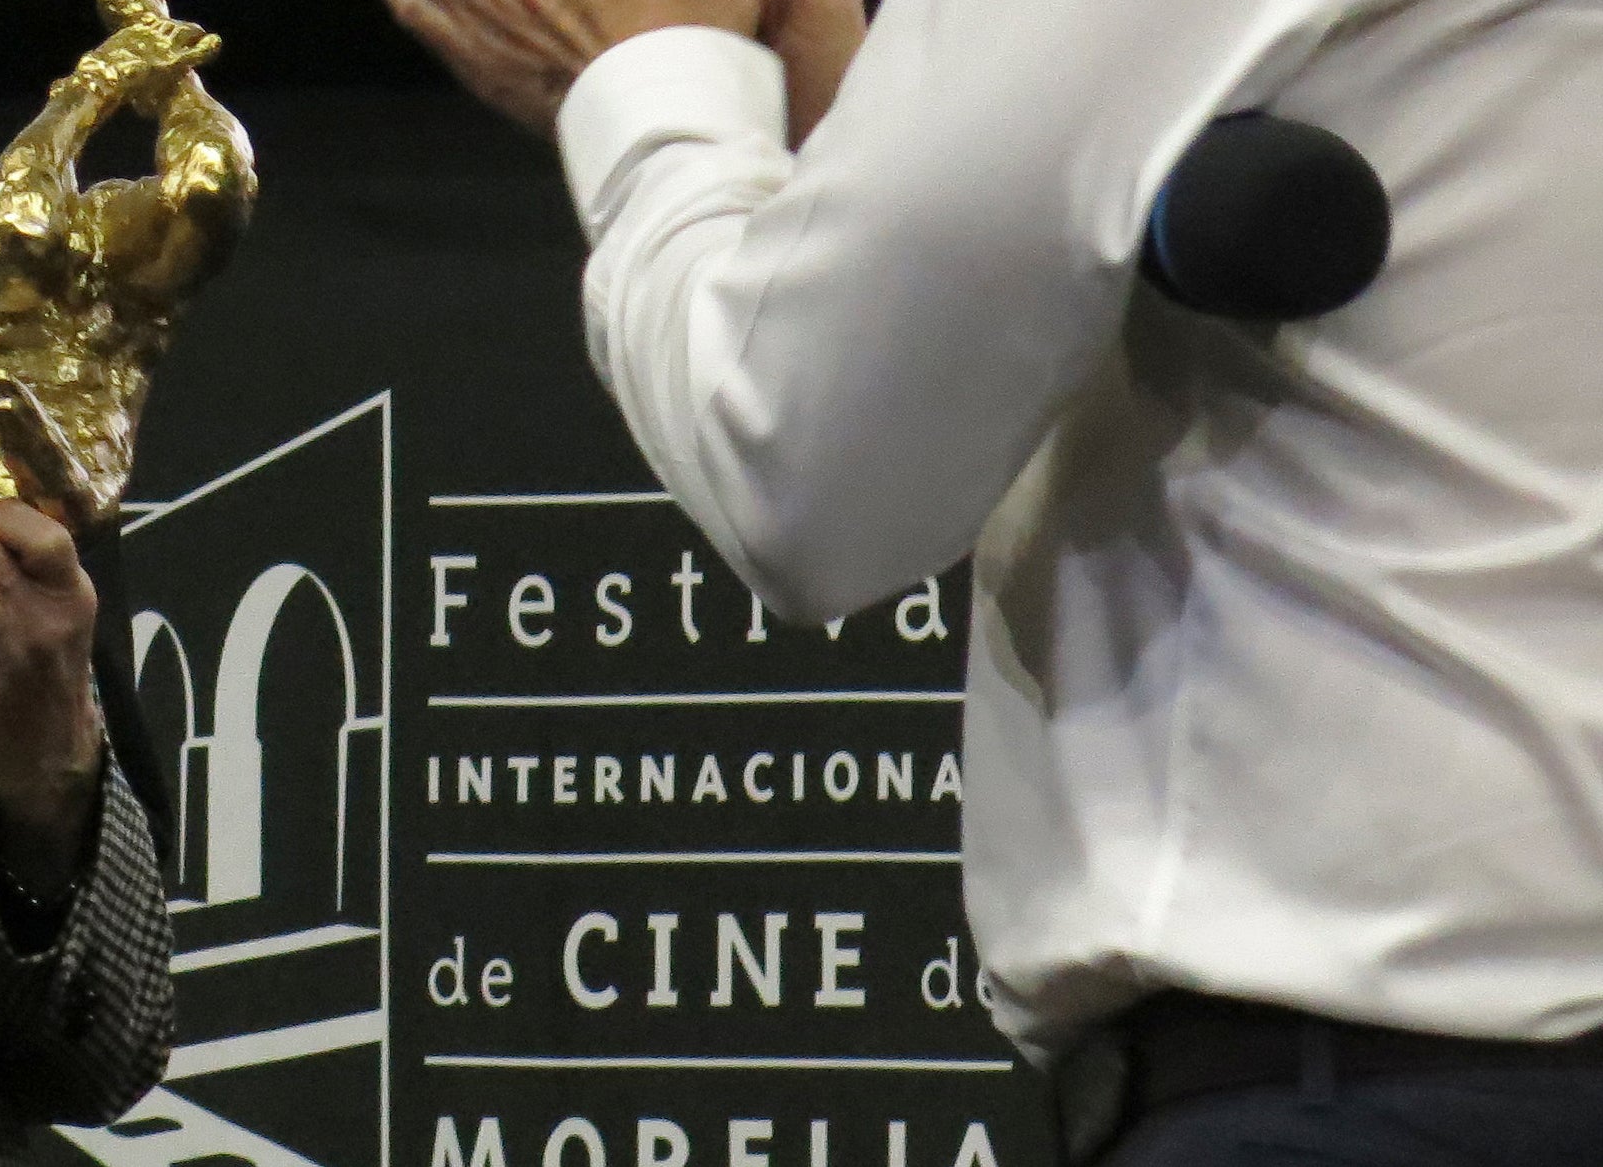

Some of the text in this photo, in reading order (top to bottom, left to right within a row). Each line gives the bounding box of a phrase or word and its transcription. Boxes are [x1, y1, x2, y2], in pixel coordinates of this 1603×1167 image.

[426, 748, 963, 804] INTERNACIONA
[426, 934, 514, 1007] de
[562, 910, 867, 1010] CINE
